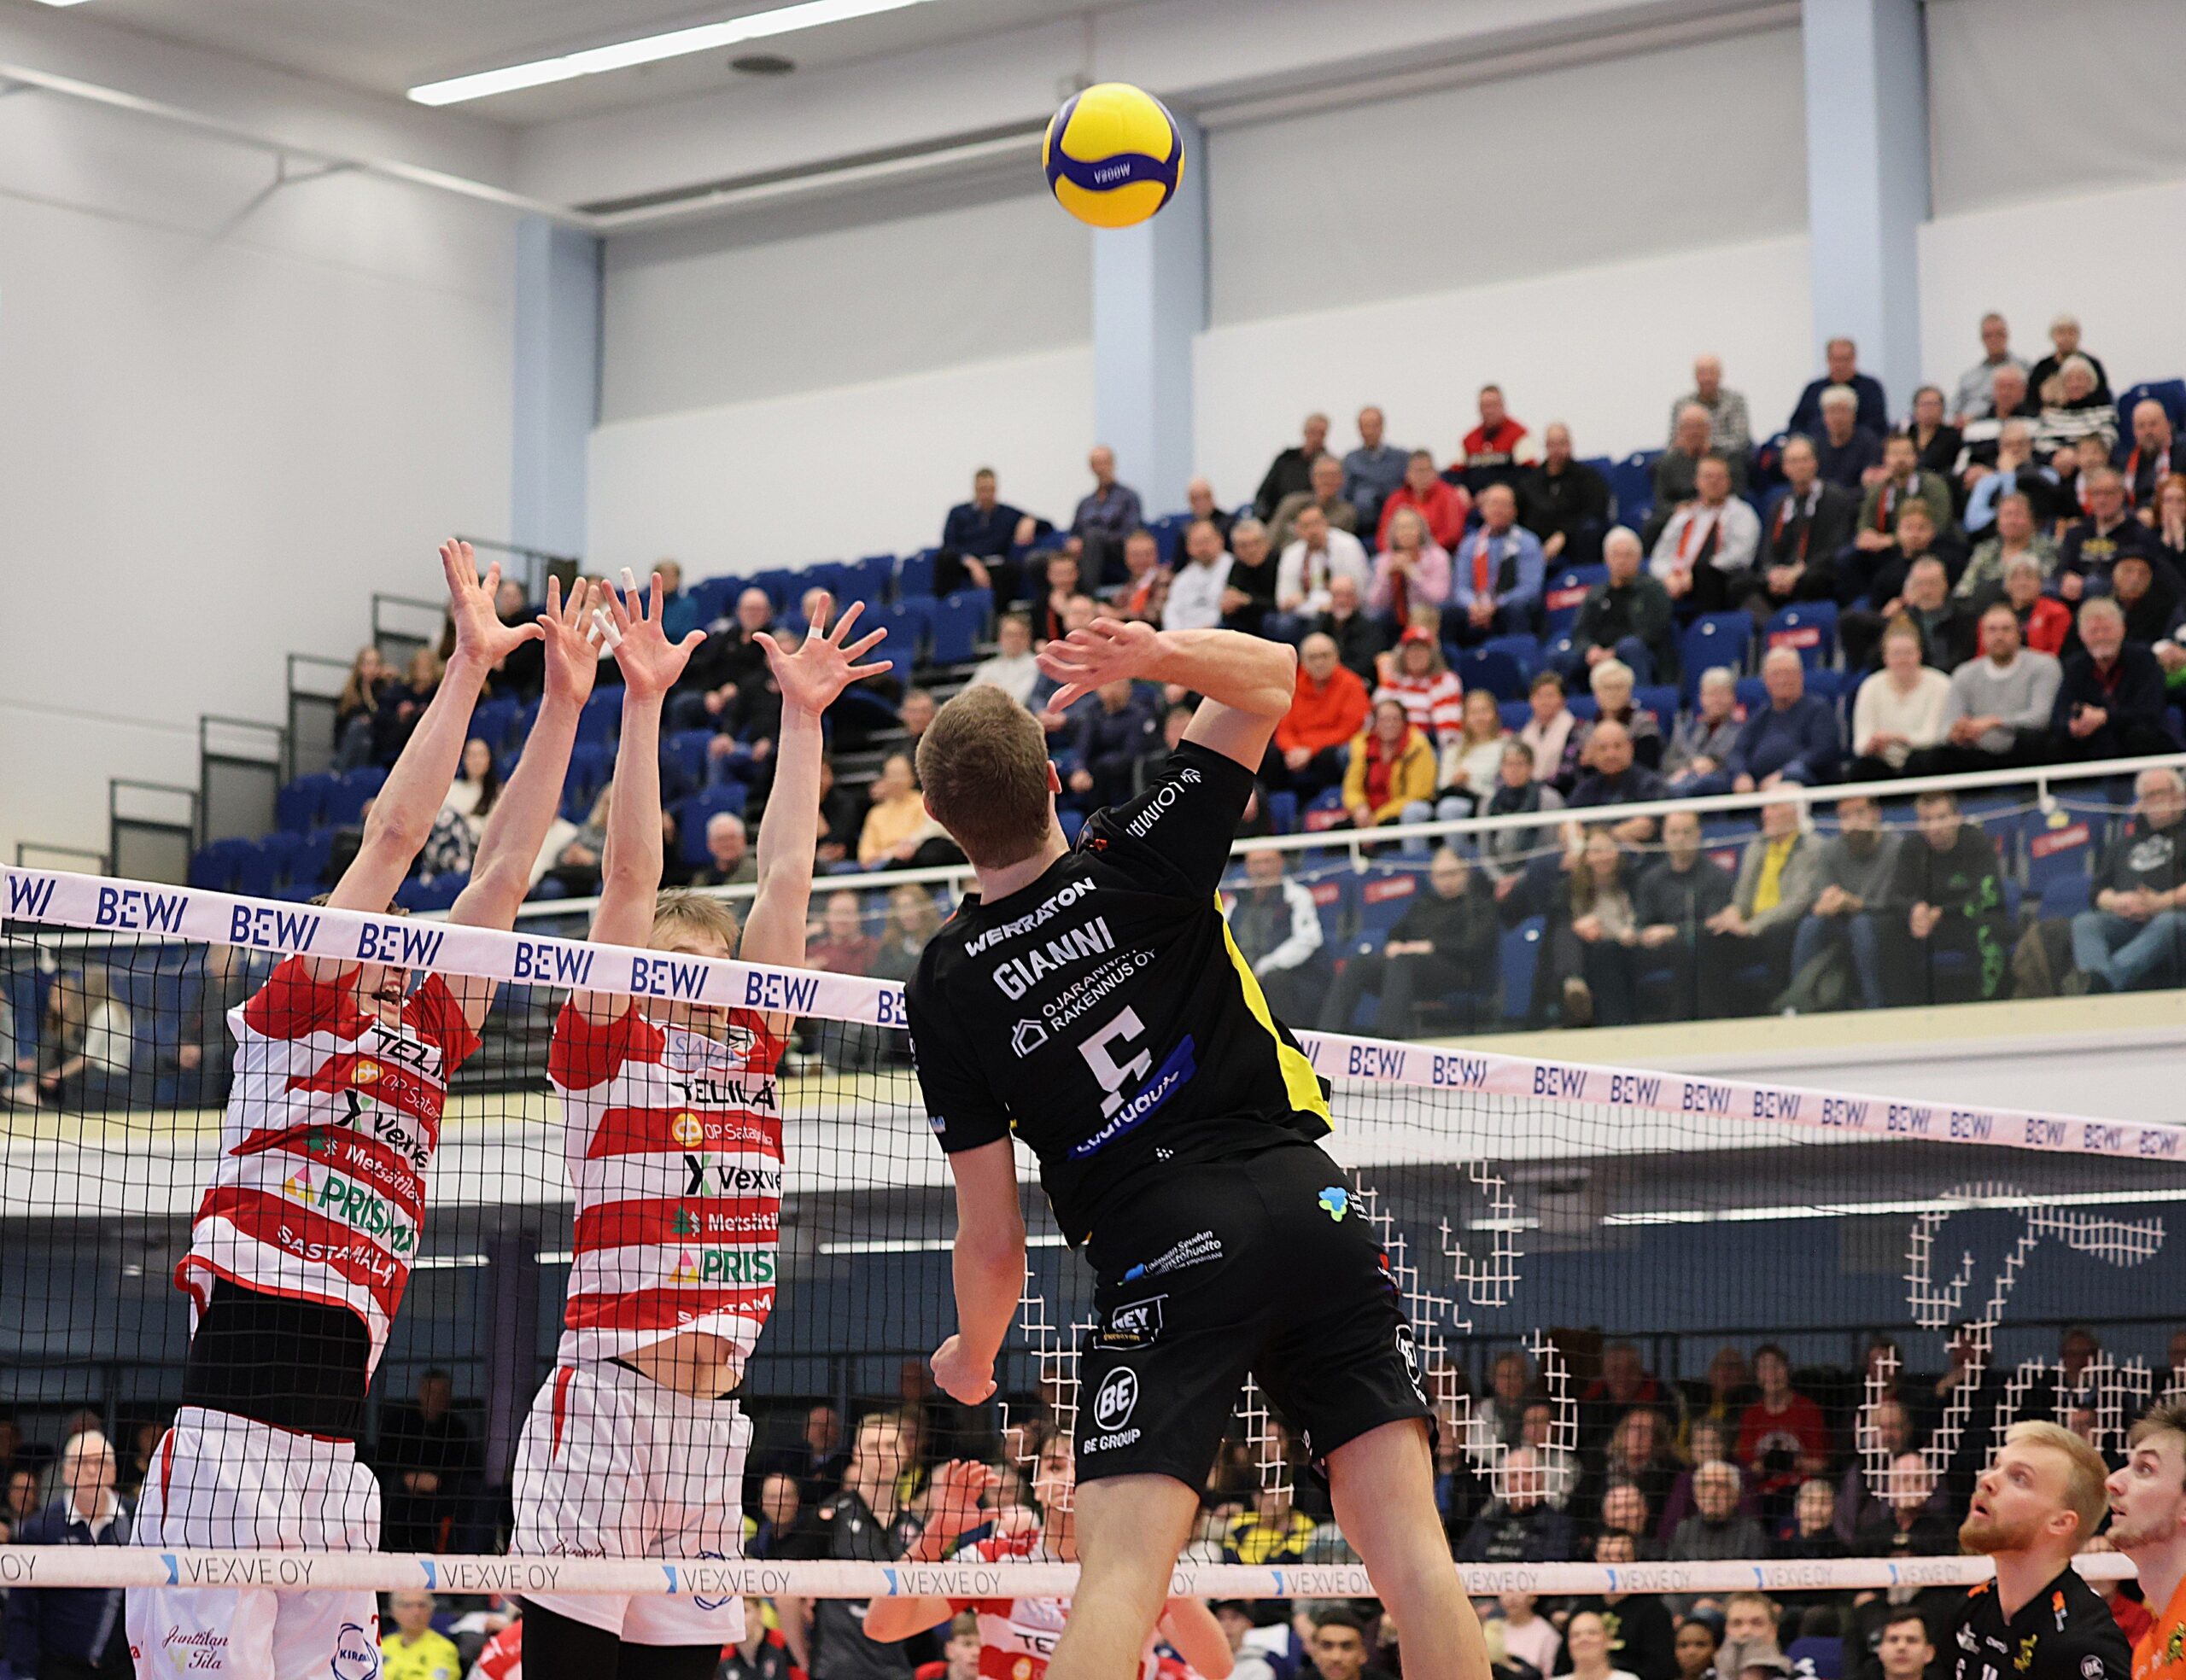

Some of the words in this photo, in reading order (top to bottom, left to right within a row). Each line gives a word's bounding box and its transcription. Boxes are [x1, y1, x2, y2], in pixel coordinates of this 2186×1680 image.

[95, 887, 188, 933] BEWI
[965, 877, 1097, 958] WERRATON
[231, 904, 320, 952] BEWI
[356, 923, 443, 967] BEWI
[992, 916, 1116, 1000] GIANNI
[512, 940, 594, 986] BEWI
[629, 956, 709, 1000] BEWI
[744, 971, 819, 1013] BEWI
[1050, 962, 1135, 1032] RAKENNUS
[1135, 948, 1155, 966] OY
[878, 990, 907, 1024] BE
[1347, 1045, 1406, 1080] BEWI
[1432, 1054, 1488, 1088] BEWI
[1534, 1065, 1587, 1099] BEWI
[1610, 1075, 1661, 1106] BEWI
[1682, 1082, 1731, 1114] BEWI
[1753, 1090, 1800, 1120] BEWI
[1821, 1098, 1868, 1127] BEWI
[1886, 1105, 1931, 1133] BEWI
[704, 1123, 722, 1140] OP
[1949, 1111, 1993, 1139] BEWI
[704, 1250, 779, 1282] PRIS
[1099, 1375, 1132, 1420] BE
[1084, 1438, 1098, 1455] BE
[1099, 1428, 1141, 1450] GROUP
[1, 1554, 37, 1581] OY
[184, 1557, 272, 1584] VEXVE
[280, 1559, 313, 1585] OY
[443, 1564, 522, 1590] VEXVE
[529, 1565, 559, 1590] OY
[682, 1568, 756, 1595] VEXVE
[762, 1570, 790, 1595] OY
[902, 1571, 970, 1595] VEXVE
[975, 1571, 1002, 1595] OY
[1289, 1572, 1345, 1594] VEXVE
[189, 1649, 222, 1670] Tila
